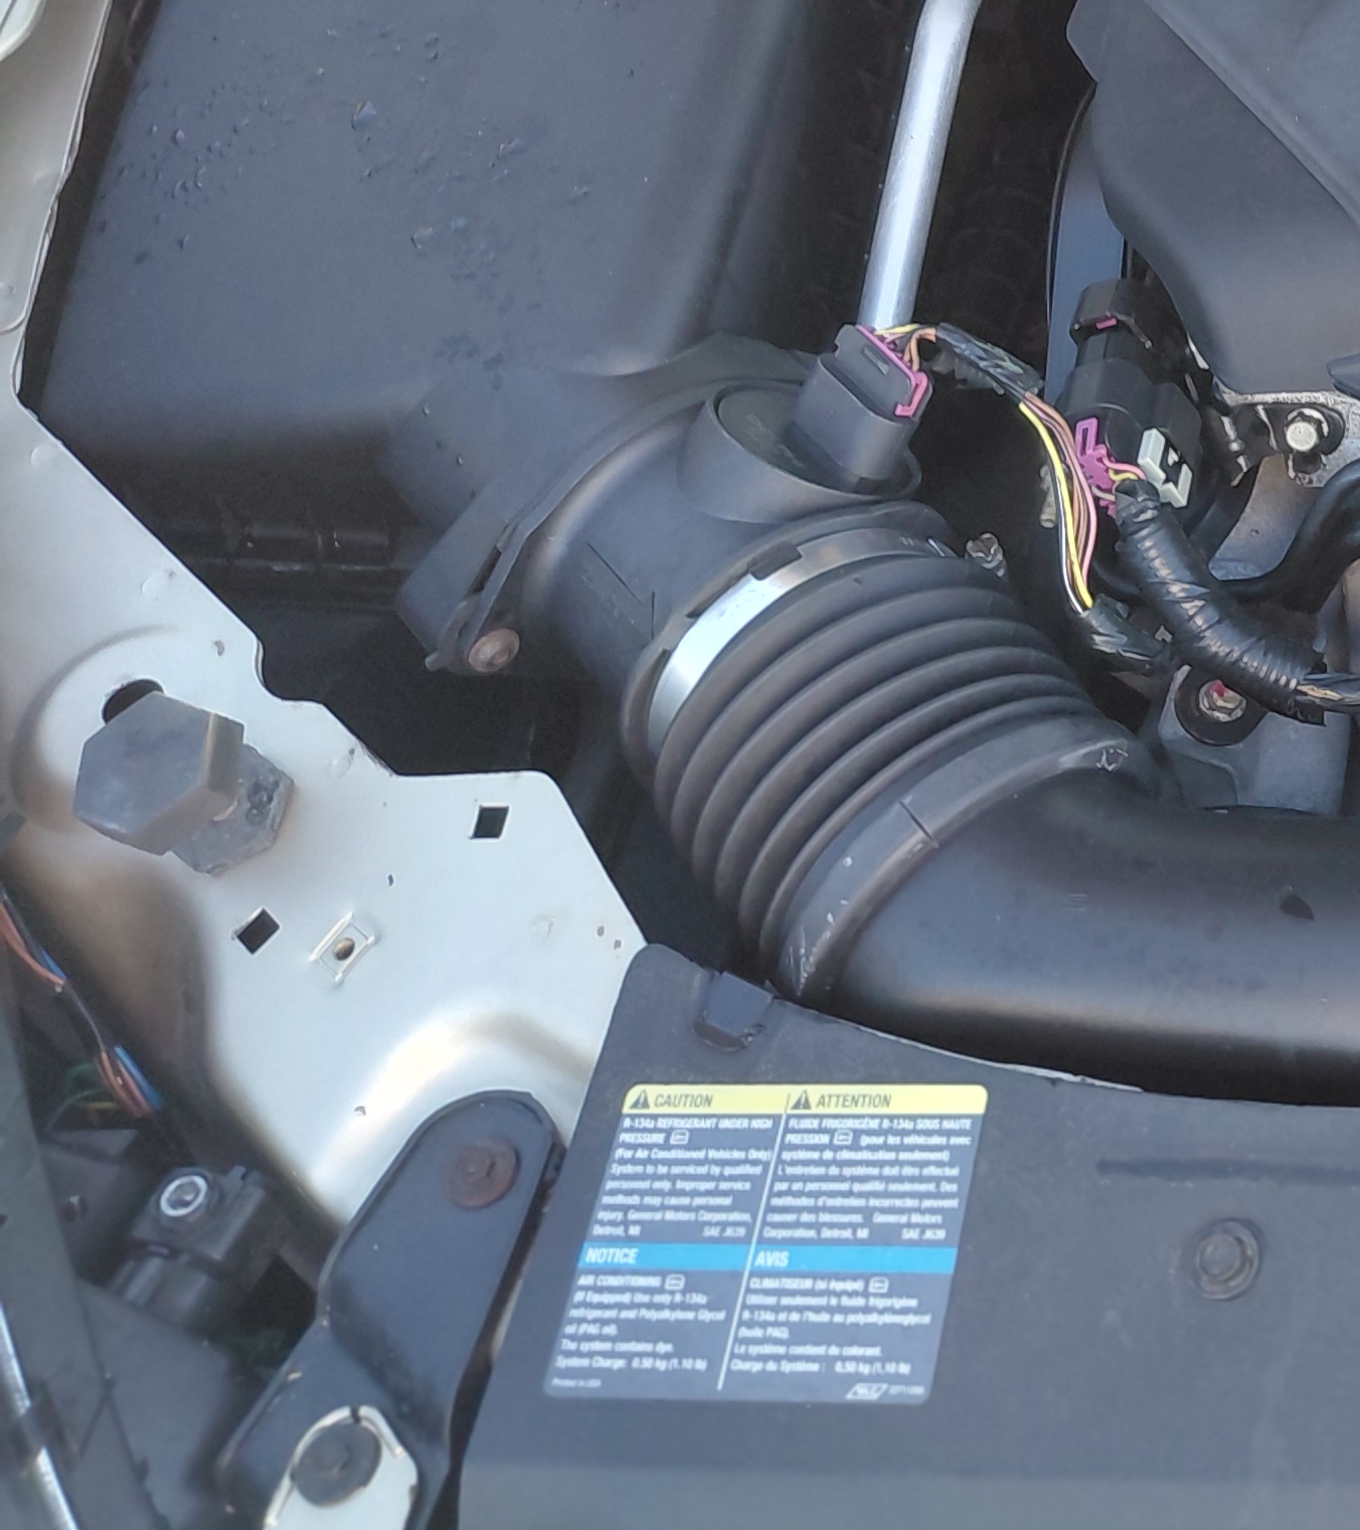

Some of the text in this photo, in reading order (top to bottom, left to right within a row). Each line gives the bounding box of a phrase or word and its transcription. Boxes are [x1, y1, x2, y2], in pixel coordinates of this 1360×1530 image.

[654, 1094, 714, 1108] CAUTION
[816, 1094, 892, 1108] ATTENTION
[623, 1117, 654, 1129] R-134a
[656, 1118, 716, 1129] REFRIGERANT
[941, 1118, 972, 1130] HAUTE
[619, 1132, 666, 1144] PRESSURE
[950, 1136, 972, 1145] avec
[614, 1148, 634, 1160] (For
[635, 1148, 650, 1159] Air
[651, 1148, 706, 1159] Conditioned
[708, 1148, 745, 1159] Vehicles
[822, 1149, 834, 1160] de
[611, 1164, 644, 1176] System
[646, 1165, 654, 1174] to
[657, 1164, 668, 1174] be
[710, 1164, 721, 1176] by
[718, 1181, 751, 1190] service
[627, 1210, 662, 1220] General
[664, 1210, 696, 1220] Motors
[873, 1212, 908, 1223] General
[910, 1212, 942, 1224] Motors
[585, 1248, 638, 1264] NOTICE
[754, 1250, 789, 1267] AVIS
[577, 1274, 596, 1287] AIR
[619, 1308, 638, 1319] and
